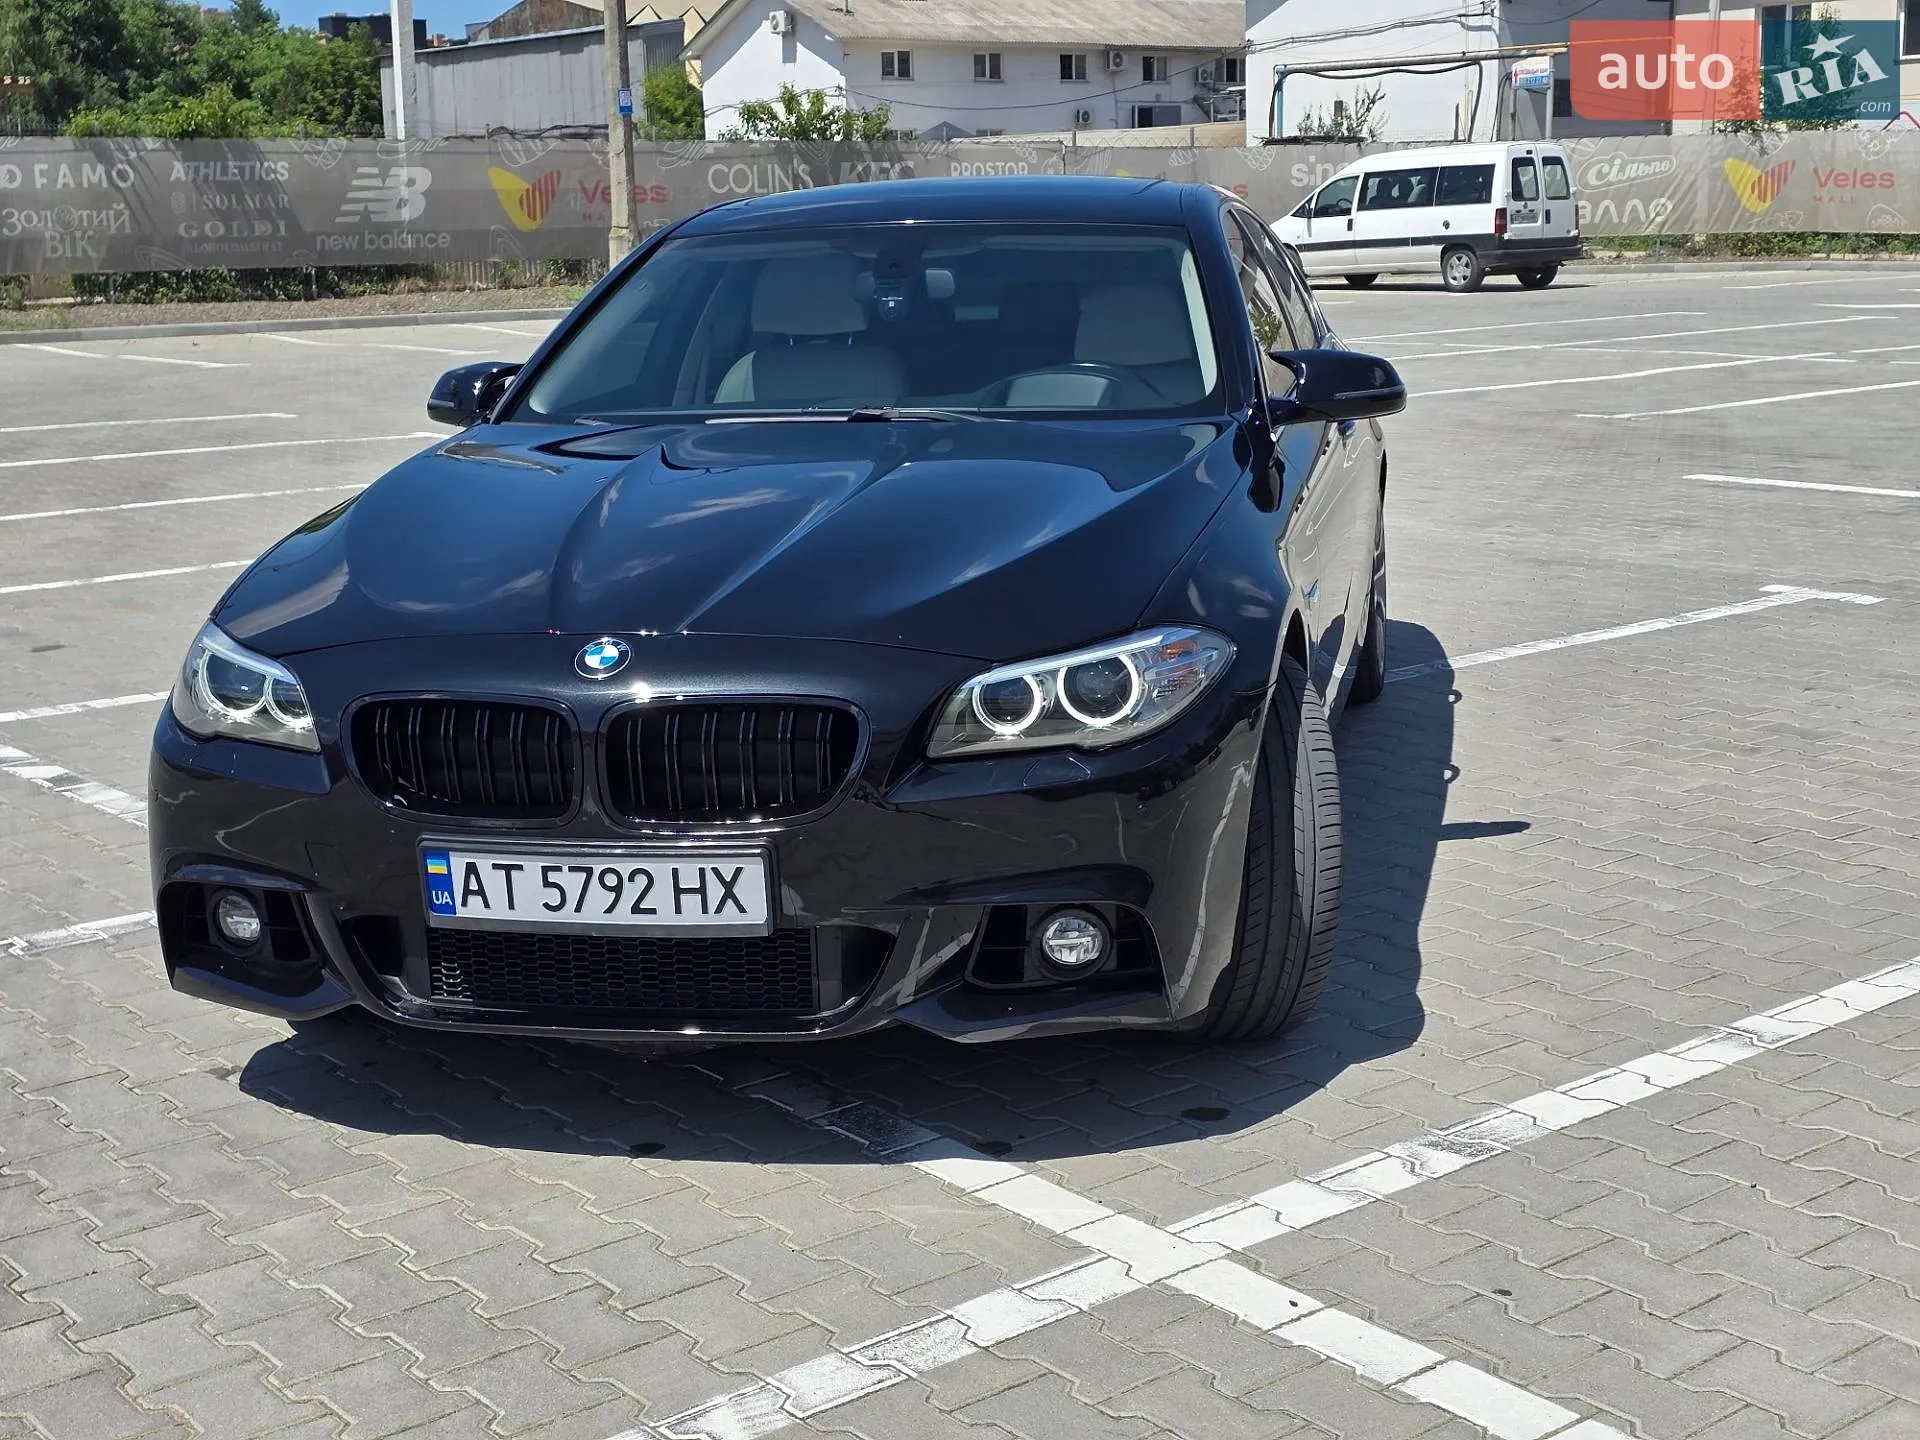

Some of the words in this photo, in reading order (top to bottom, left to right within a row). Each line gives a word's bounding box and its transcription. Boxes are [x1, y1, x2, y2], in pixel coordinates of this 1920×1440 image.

[33, 163, 136, 189] FAMO
[169, 160, 290, 182] ATHLETICS
[707, 157, 815, 194] COLIN'S
[1586, 158, 1672, 186] Сільпо
[1812, 167, 1896, 189] Veles
[577, 179, 668, 205] Vees
[1812, 194, 1856, 204] MALL
[179, 219, 289, 239] GOLDI
[316, 233, 360, 250] new
[364, 228, 452, 249] balance
[432, 890, 453, 905] UA
[460, 861, 524, 911] AT
[539, 864, 657, 915] 5792
[671, 866, 748, 915] HX
